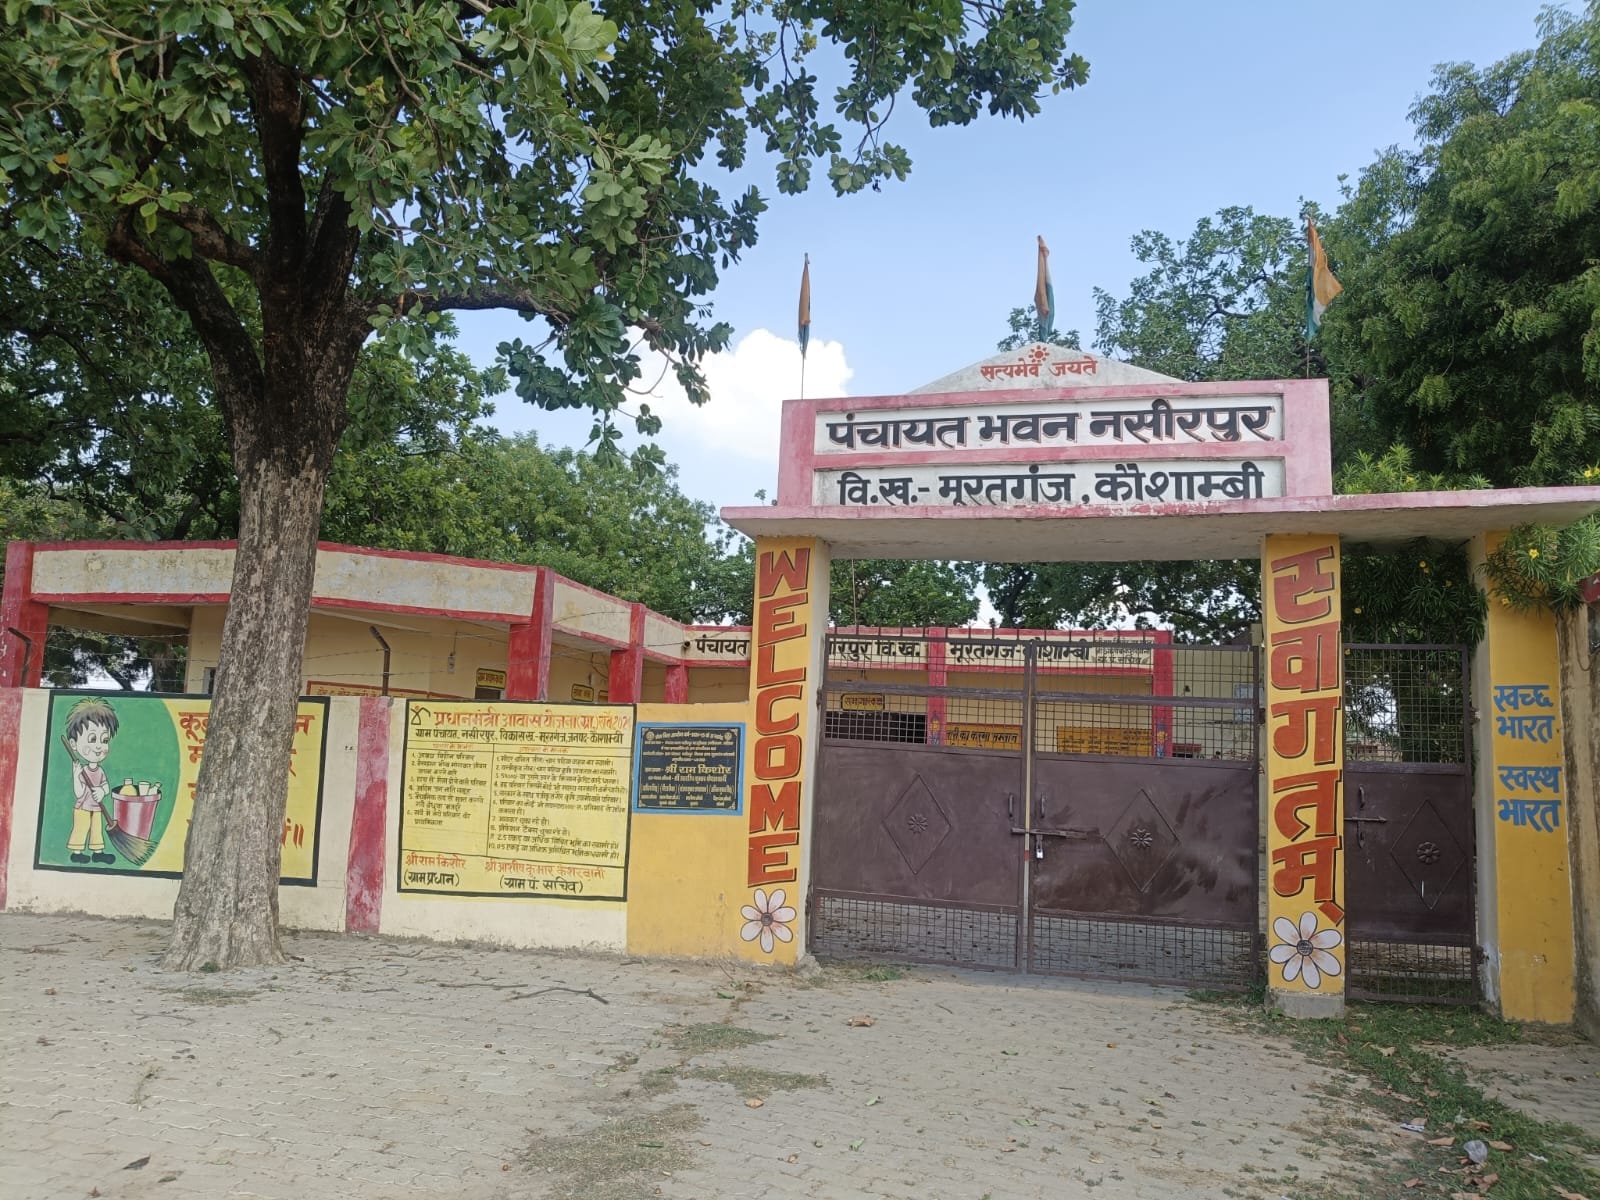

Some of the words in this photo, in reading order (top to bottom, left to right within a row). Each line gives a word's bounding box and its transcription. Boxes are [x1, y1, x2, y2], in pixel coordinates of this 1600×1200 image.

[980, 357, 1042, 382] सत्यमेव
[1048, 355, 1098, 376] जयते
[826, 413, 971, 449] पंचायत
[977, 412, 1082, 443] भवन
[1089, 398, 1276, 443] नसीरपुर
[1094, 461, 1265, 502] कौशाम्बी
[694, 634, 750, 656] पंचायत
[1493, 685, 1554, 712] स्वच्छ
[434, 706, 499, 727] प्रधानमंत्री
[748, 547, 811, 888] WELCOME
[1496, 716, 1555, 743] भारत
[416, 728, 431, 738] ग्राम
[1271, 546, 1344, 926] स्वागतम्
[1497, 766, 1562, 793] स्वस्थ
[1497, 799, 1561, 833] भारत
[418, 856, 436, 867] राम
